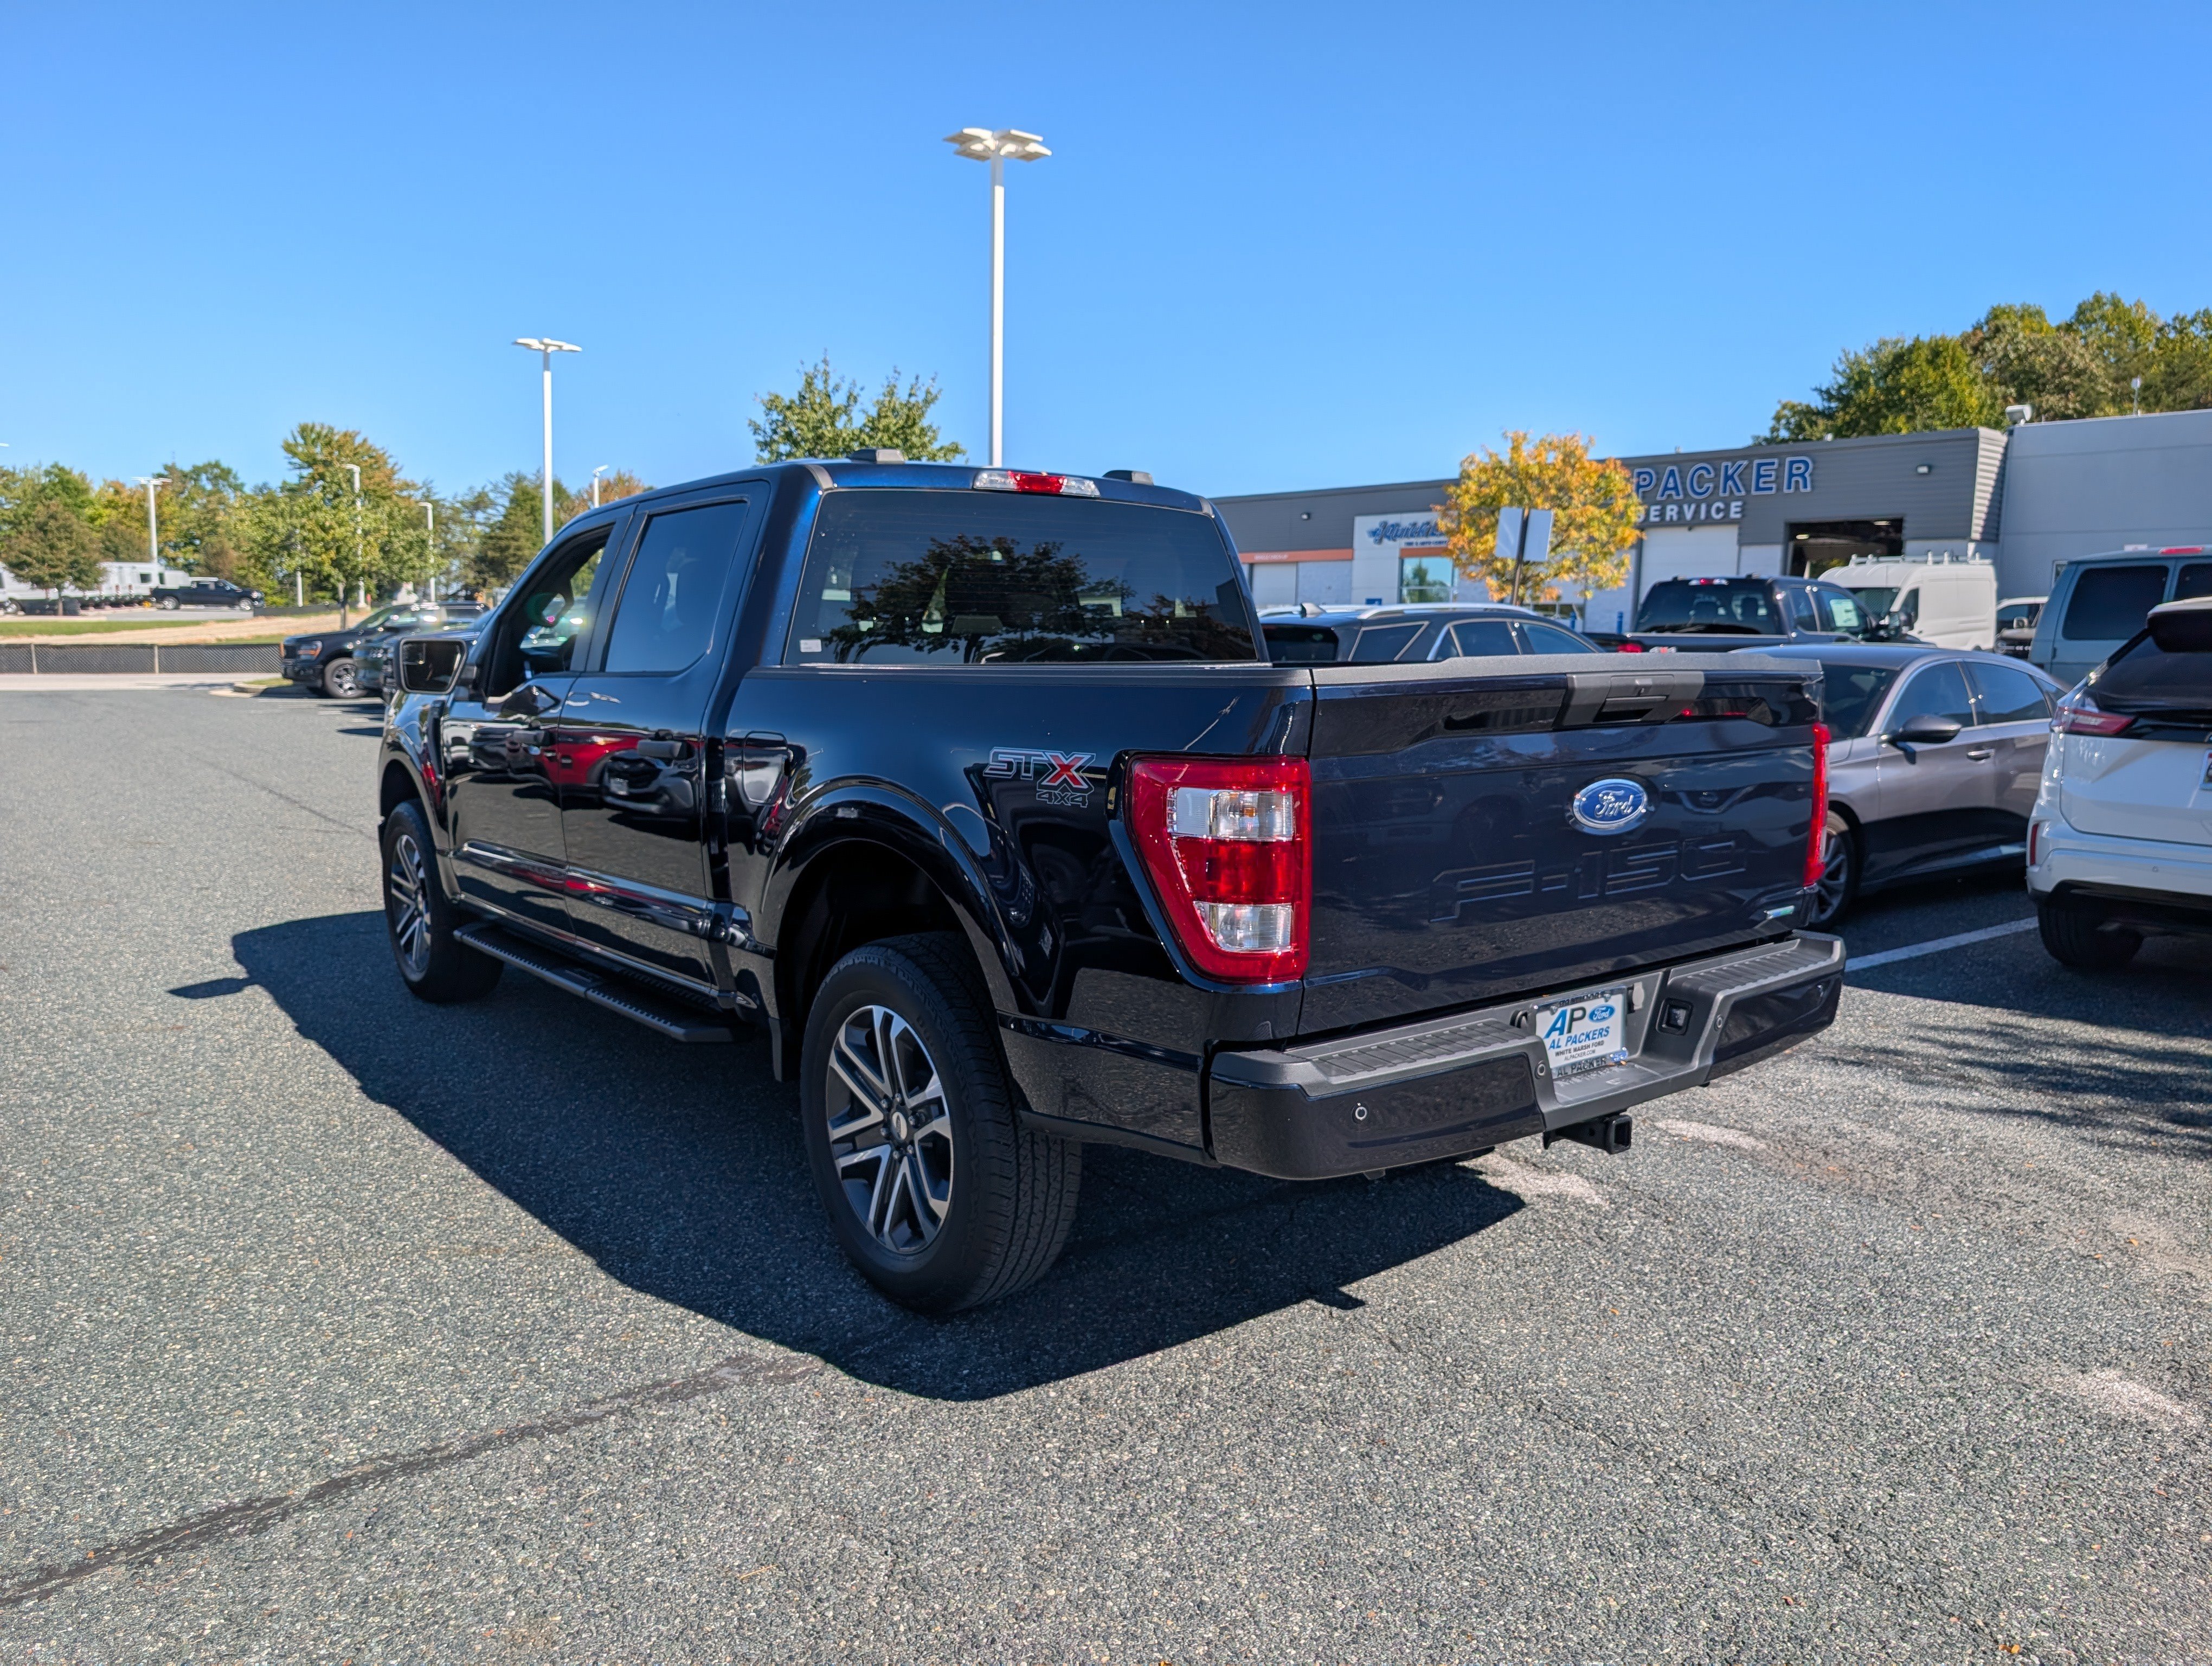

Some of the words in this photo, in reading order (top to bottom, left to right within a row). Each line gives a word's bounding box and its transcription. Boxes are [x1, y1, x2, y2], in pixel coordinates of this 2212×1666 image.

[1632, 456, 1814, 501] PACKER
[983, 746, 1096, 794] STX
[1543, 1006, 1586, 1039] AP
[1592, 1007, 1611, 1021] Ford
[1548, 1038, 1561, 1050] AL
[1565, 1026, 1610, 1047] PACKERS
[1555, 1048, 1571, 1057] WHITE
[1573, 1044, 1590, 1053] MARSH
[1591, 1040, 1604, 1049] FORD
[1557, 1068, 1568, 1077] AL
[1571, 1058, 1606, 1072] PACKER
